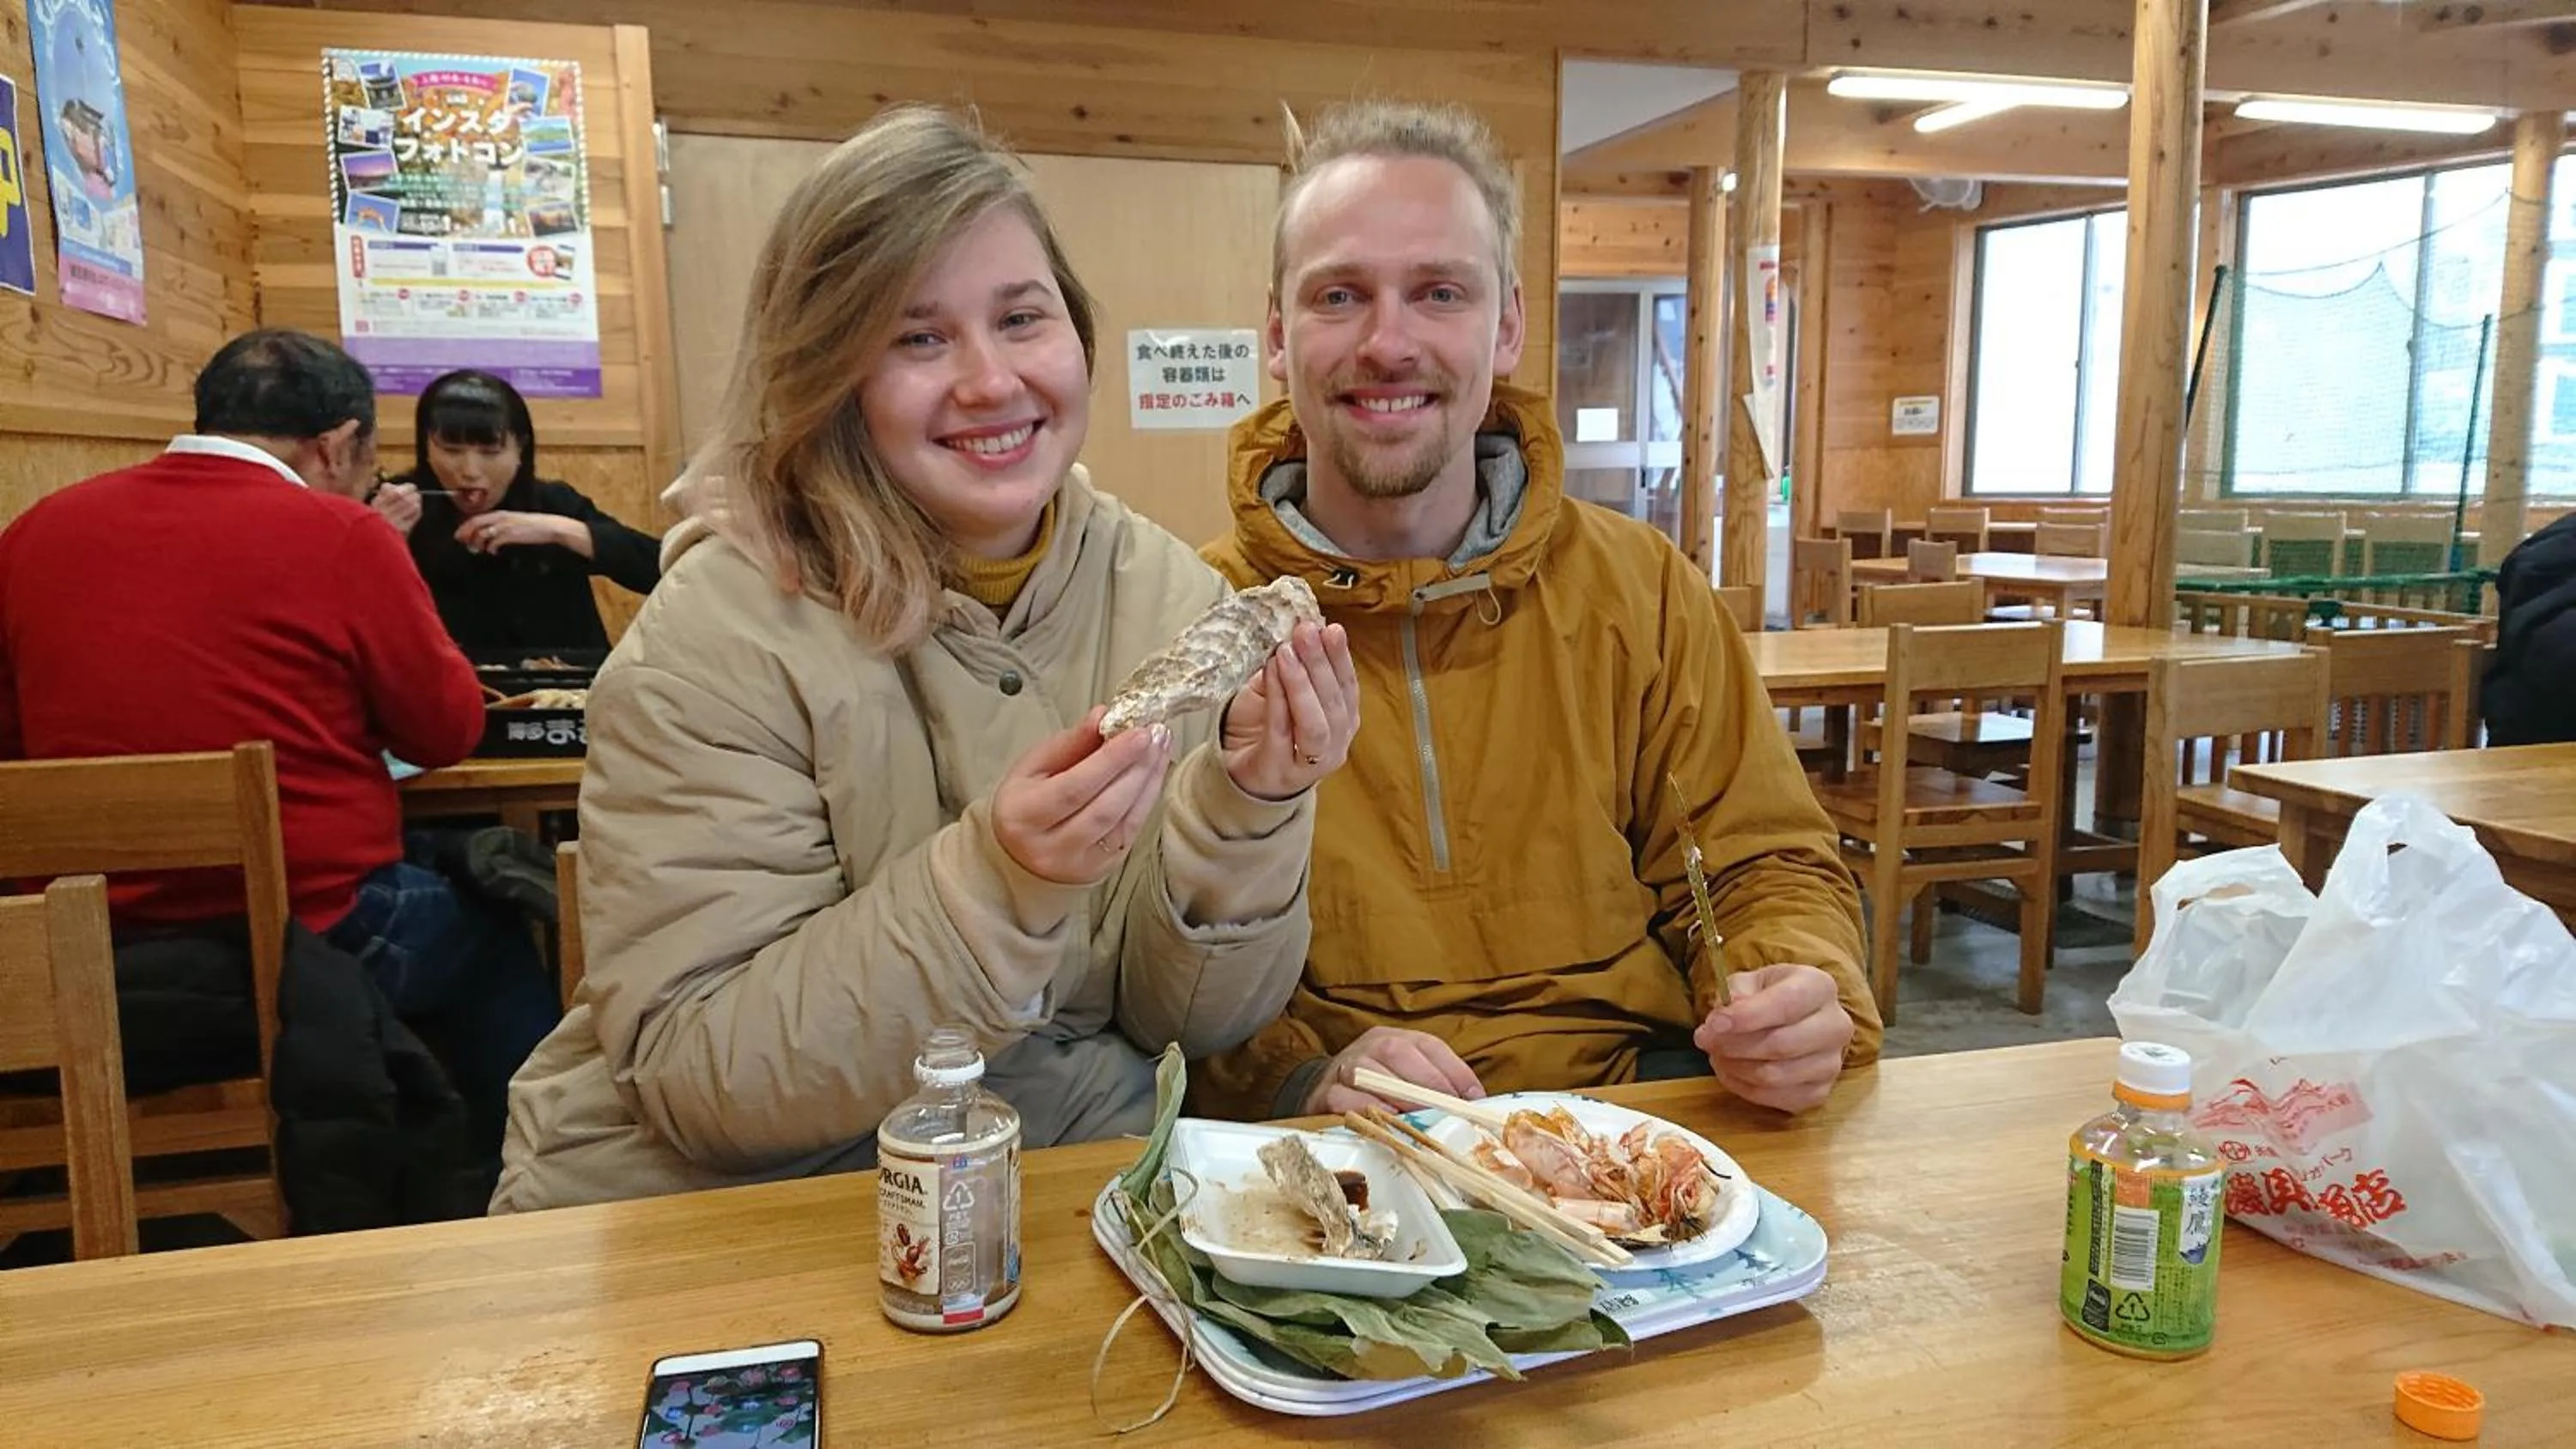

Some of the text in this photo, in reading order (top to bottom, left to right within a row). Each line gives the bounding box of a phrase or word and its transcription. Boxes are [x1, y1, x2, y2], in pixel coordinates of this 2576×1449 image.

[401, 106, 512, 135] インスタ
[394, 137, 523, 164] フォトコン
[1137, 343, 1250, 360] 食べ終えた後の
[1163, 366, 1226, 383] 容器類は
[1139, 391, 1251, 409] 指定のごみ箱へ
